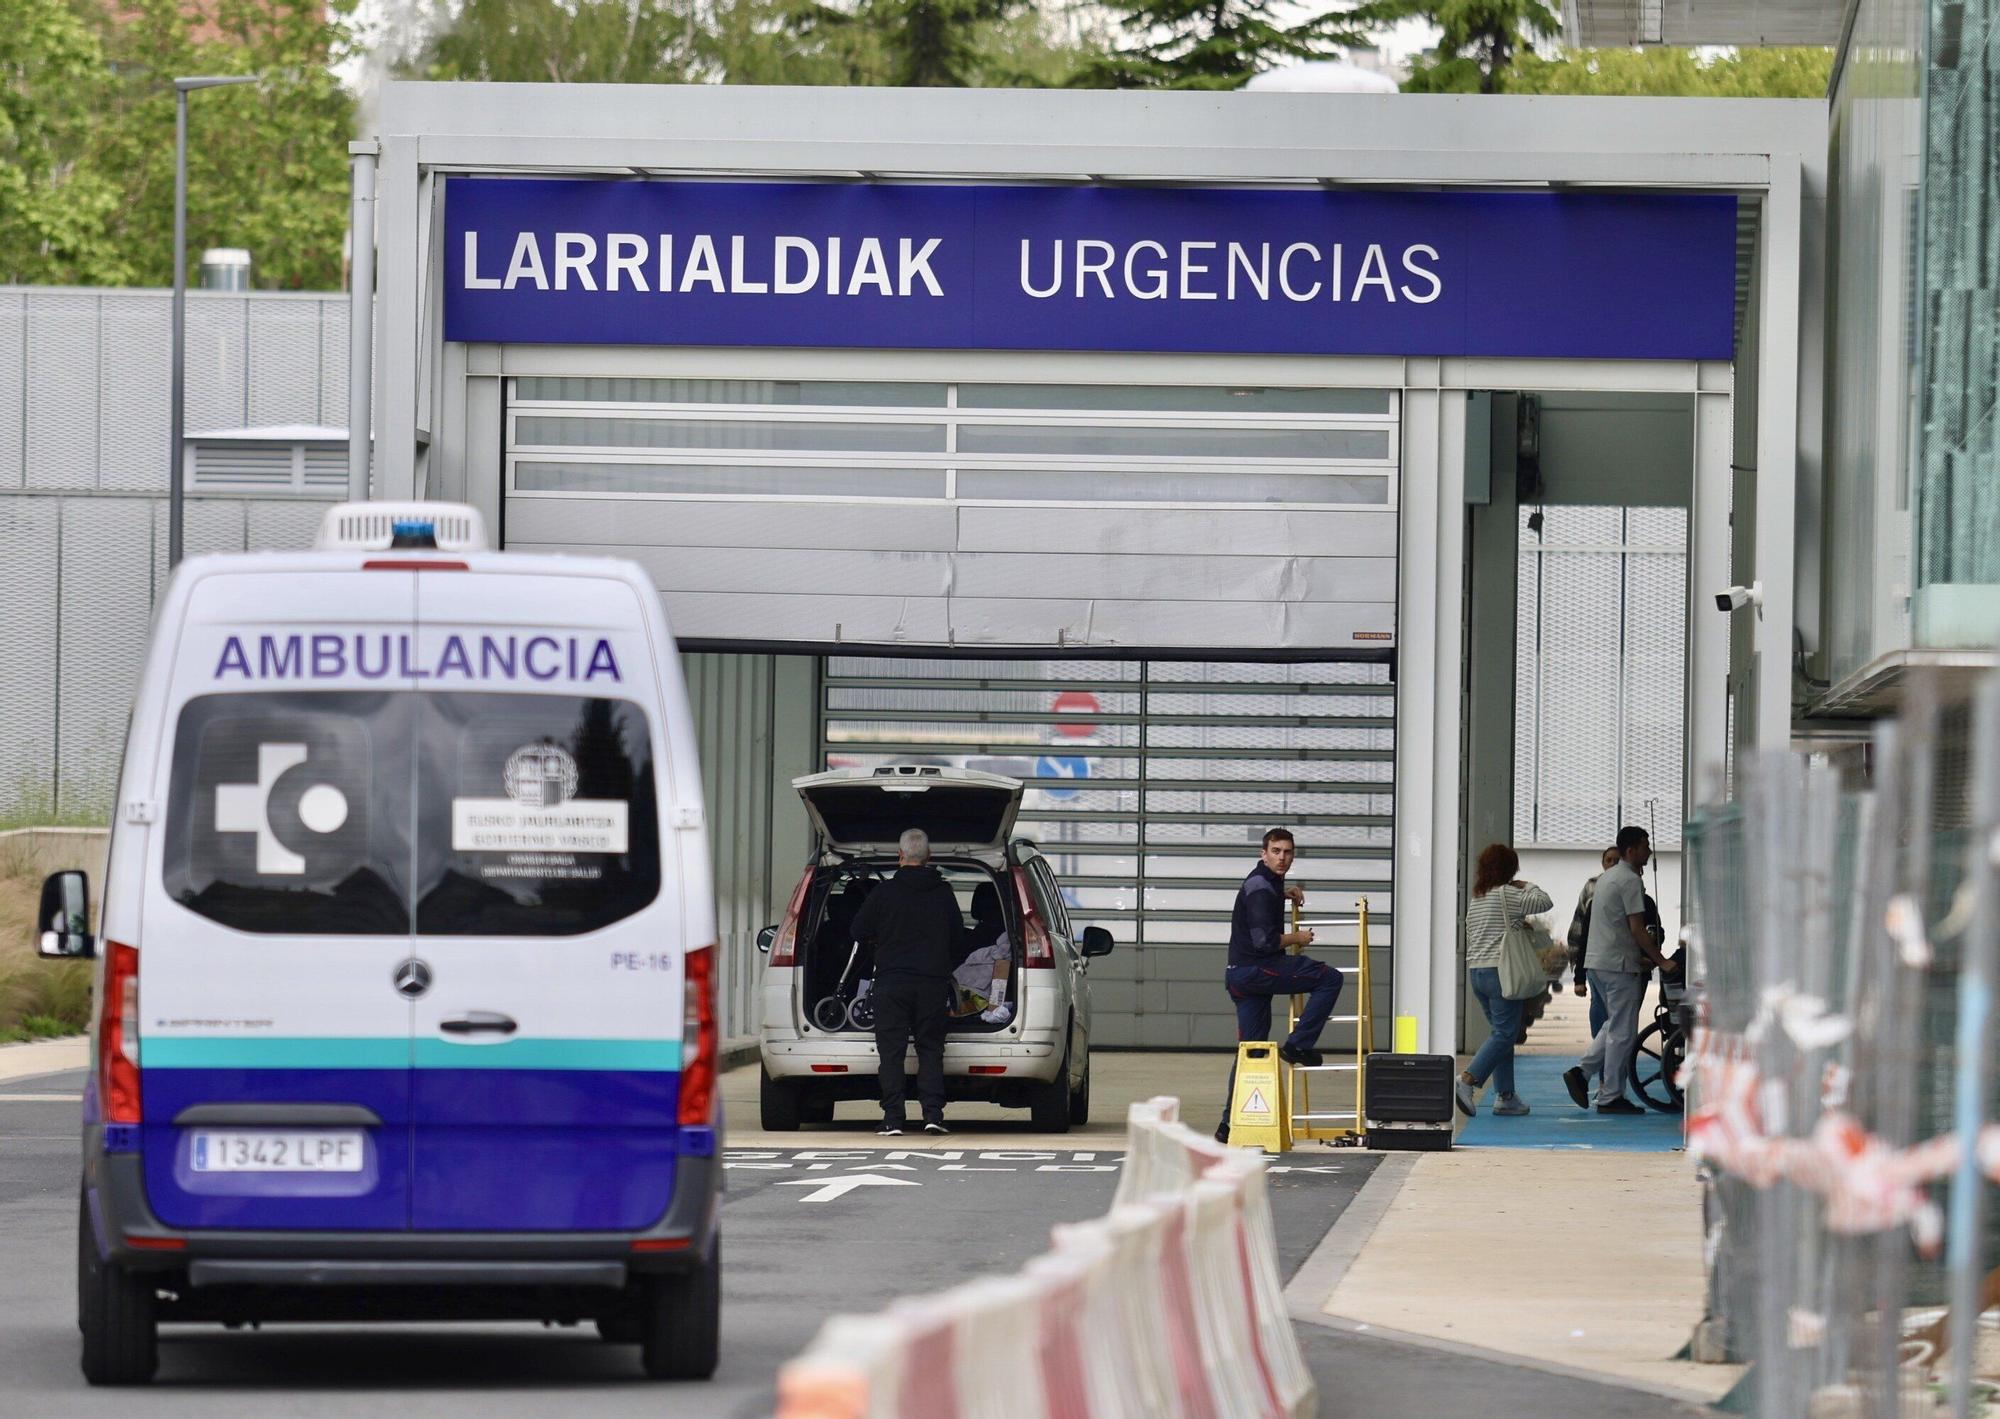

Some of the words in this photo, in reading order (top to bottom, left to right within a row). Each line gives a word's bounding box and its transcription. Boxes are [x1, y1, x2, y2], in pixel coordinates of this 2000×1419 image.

[463, 230, 945, 297] LARRIALDIAK
[1019, 238, 1443, 304] URGENCIAS
[213, 634, 622, 682] AMBULANCIA
[218, 1139, 289, 1166] 1342
[299, 1139, 354, 1166] LPF
